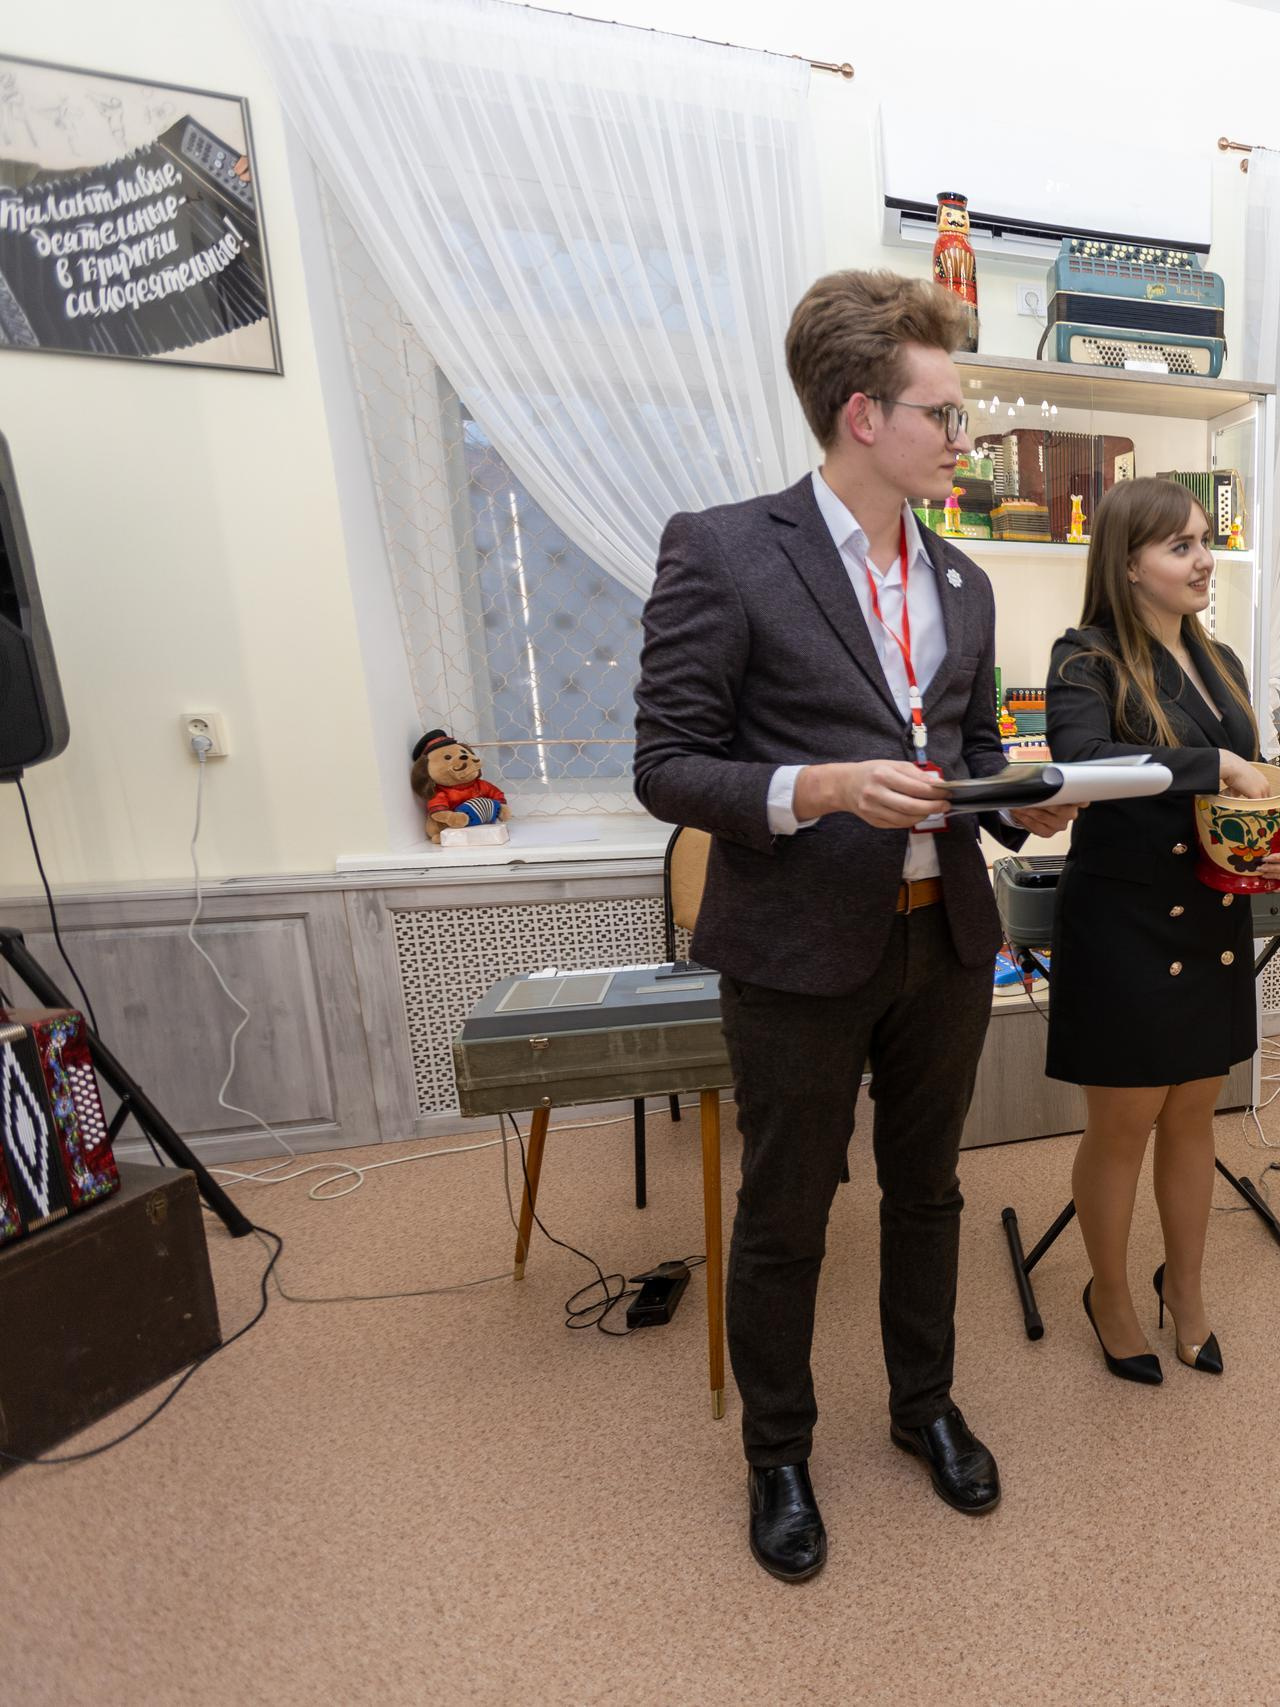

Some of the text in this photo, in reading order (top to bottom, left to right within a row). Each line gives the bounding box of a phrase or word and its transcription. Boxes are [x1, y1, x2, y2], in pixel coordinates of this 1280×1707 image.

[56, 229, 179, 289] в кружки
[65, 216, 250, 319] самодеятельные!
